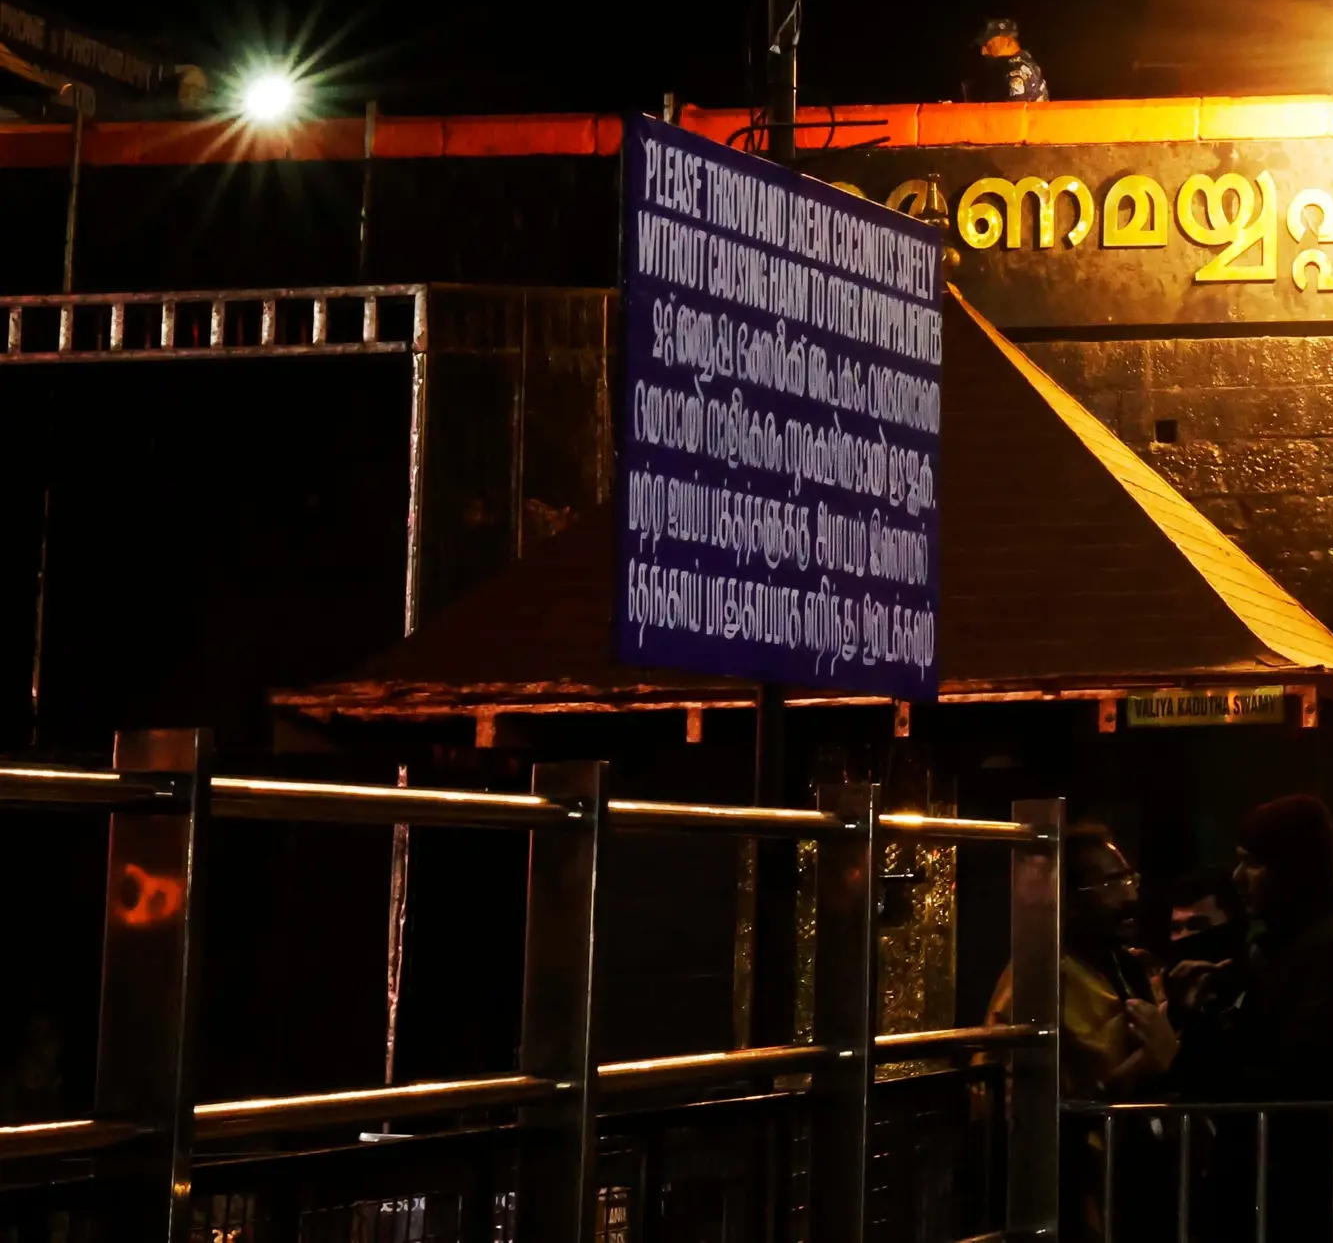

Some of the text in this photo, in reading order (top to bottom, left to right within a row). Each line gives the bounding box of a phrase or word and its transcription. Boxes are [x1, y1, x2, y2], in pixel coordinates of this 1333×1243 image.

[645, 138, 935, 300] PLEASE THROW AND BREAK COCONUTS SAFELY
[637, 210, 707, 290] WITHOUT
[707, 234, 767, 309] CAUSING
[768, 255, 808, 322] HARM
[810, 267, 824, 328] TO
[826, 275, 860, 340] OTHER
[860, 286, 904, 354] AYYAPPA
[808, 343, 865, 412] അപകടം
[1135, 697, 1174, 718] VALIYA
